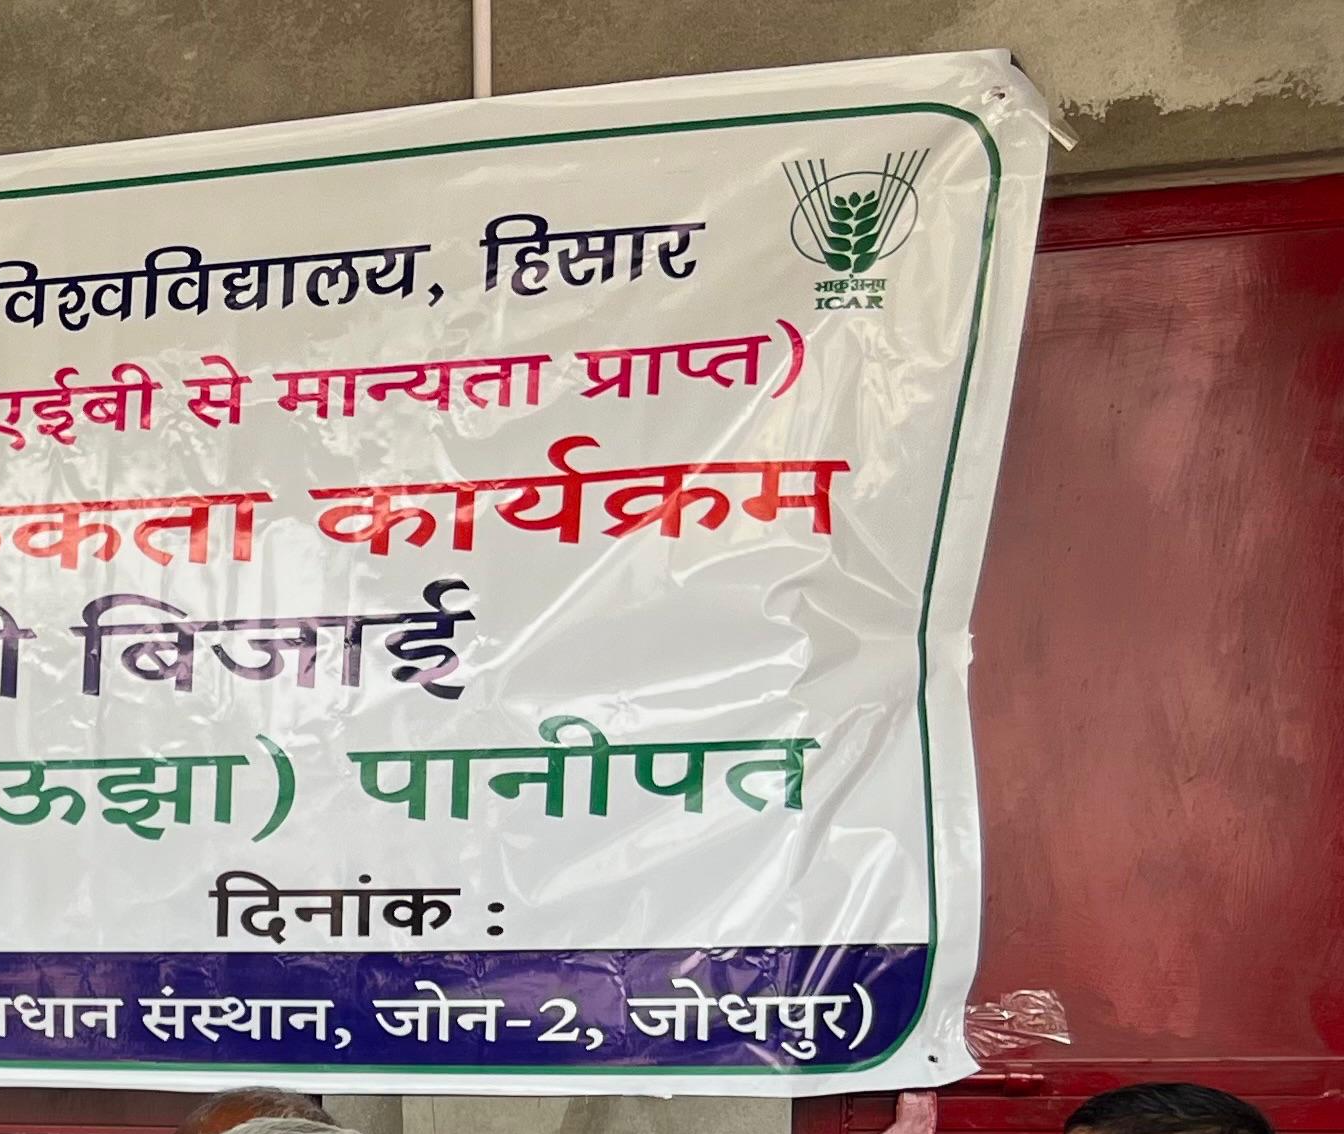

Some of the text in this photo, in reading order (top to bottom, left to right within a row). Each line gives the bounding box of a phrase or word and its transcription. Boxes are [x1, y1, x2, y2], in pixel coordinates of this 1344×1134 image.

[481, 212, 704, 296] हिसार
[815, 295, 884, 310] ICAR
[185, 355, 251, 430] से
[275, 353, 552, 421] मान्यता
[579, 319, 806, 401] प्राप्त)
[309, 435, 849, 557] कार्यक्रम
[70, 579, 475, 700] बिजाई
[347, 715, 820, 820] पानीपत
[208, 871, 460, 944] दिनांक
[141, 981, 352, 1047] संस्थान,
[373, 979, 604, 1048] जोन-2,
[629, 977, 873, 1058] जोधपुर)
